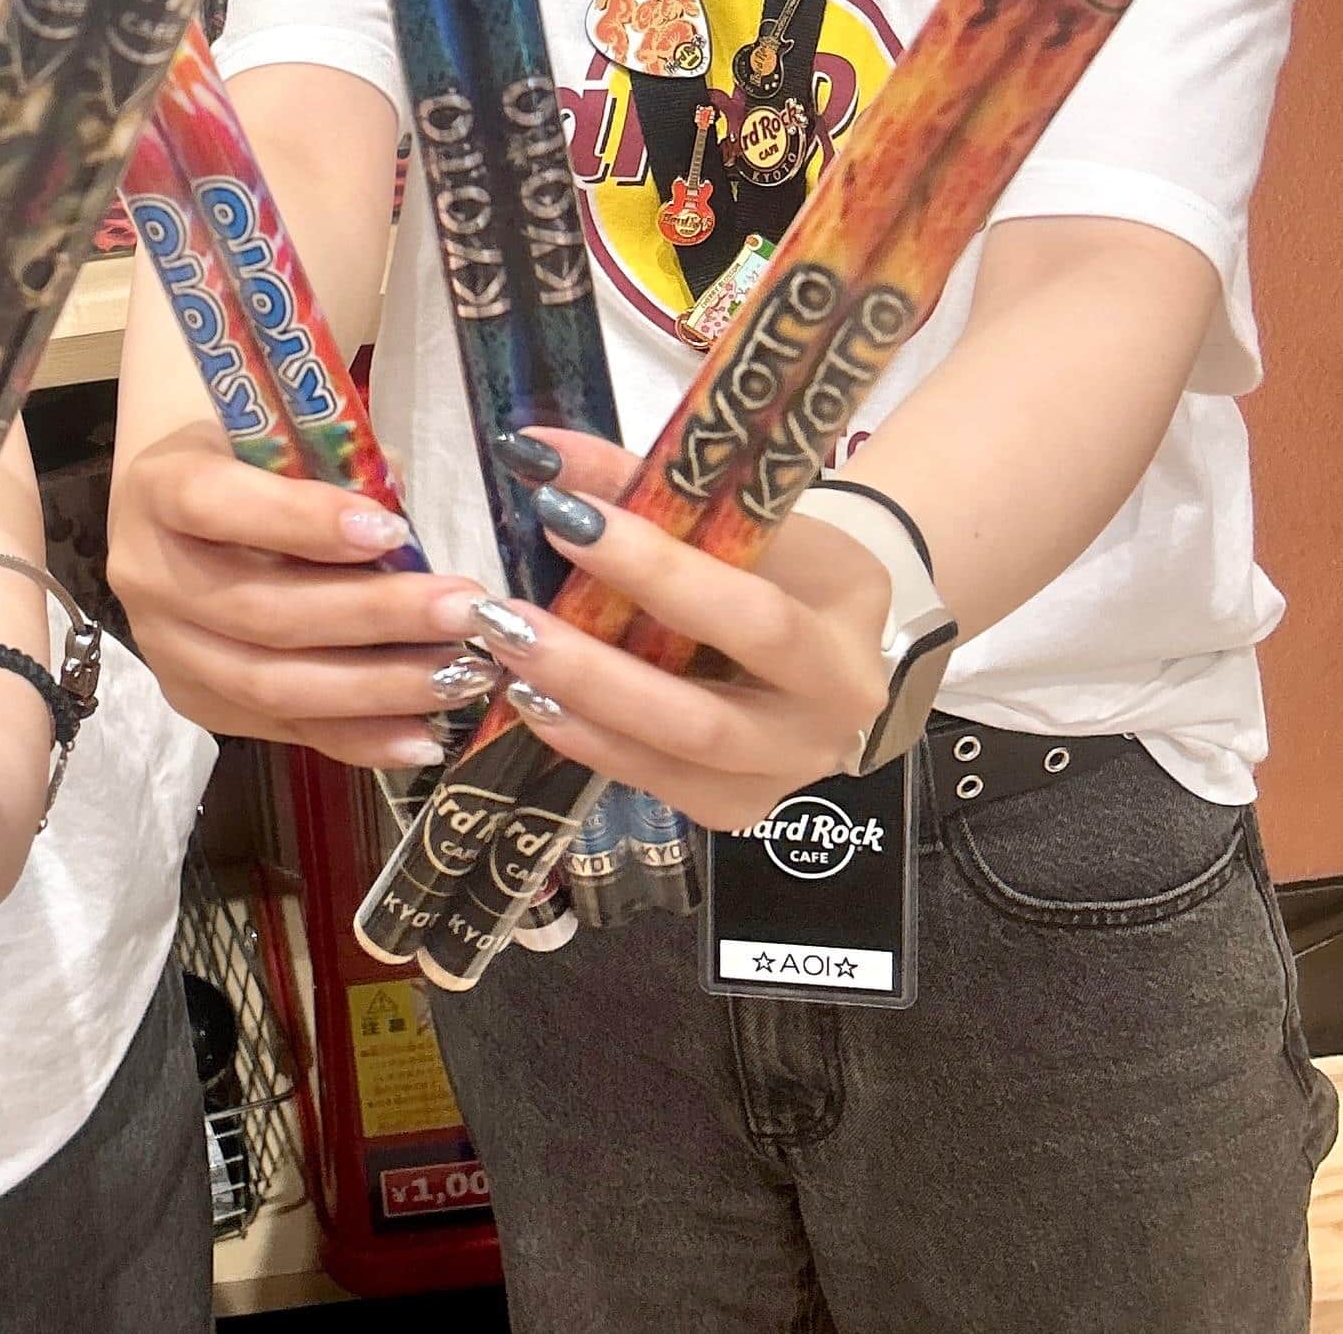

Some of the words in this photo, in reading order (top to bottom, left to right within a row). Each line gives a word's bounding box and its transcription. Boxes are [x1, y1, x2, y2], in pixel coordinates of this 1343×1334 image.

[419, 87, 512, 319] KYOTO
[503, 75, 590, 306] KYOTO
[752, 152, 797, 183] KYOTO
[759, 104, 799, 140] Rock
[128, 193, 274, 441] KYOTO
[193, 176, 339, 426] KYOTO
[670, 268, 839, 498] KYOTO
[741, 287, 912, 524] KYOTO
[789, 850, 830, 864] CAFE
[810, 815, 885, 852] Rock
